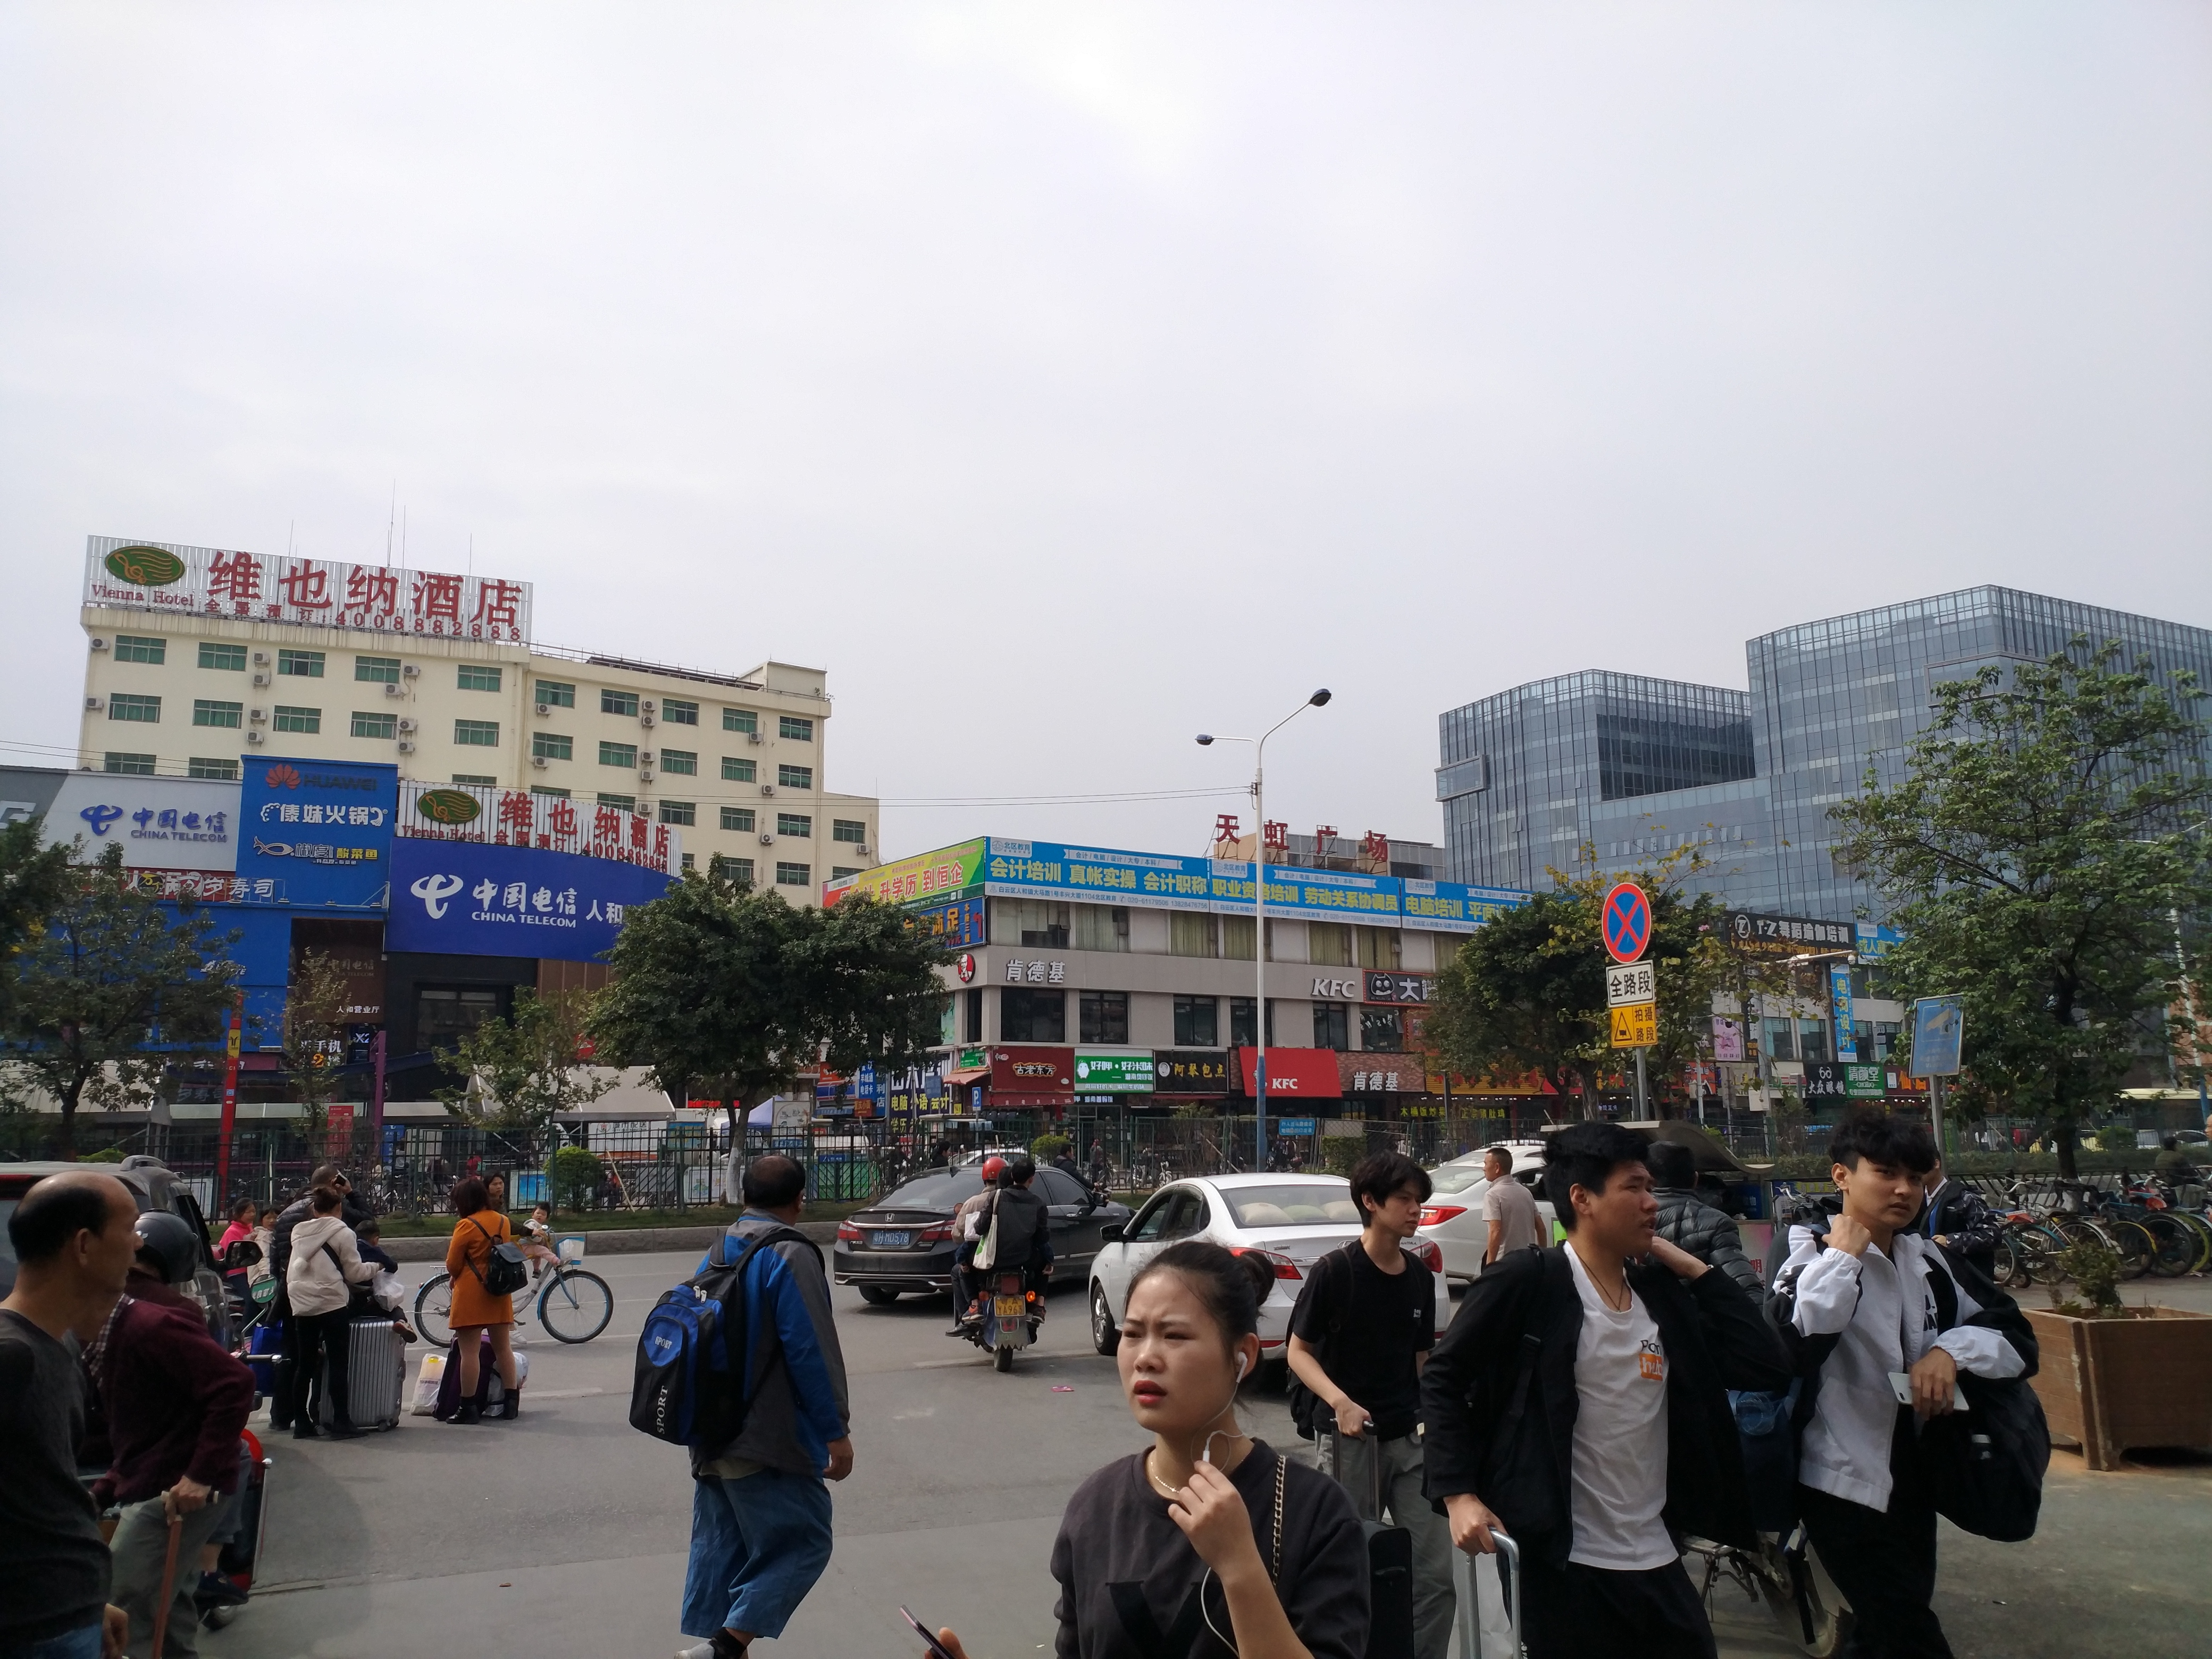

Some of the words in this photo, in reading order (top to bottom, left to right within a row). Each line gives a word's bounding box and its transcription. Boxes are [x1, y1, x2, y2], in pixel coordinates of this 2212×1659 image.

[91, 585, 144, 601] Vienna
[153, 590, 194, 606] Hotel
[208, 551, 522, 627] 维也纳酒店
[304, 774, 378, 791] HUAWEI
[132, 807, 228, 833] 中国电信
[499, 790, 670, 858] 维也纳酒店
[131, 830, 168, 840] CHINA
[169, 832, 227, 843] TELECOM
[402, 825, 445, 839] Vienna
[449, 828, 486, 842] Hotel
[1217, 814, 1388, 862] 天虹广场
[1004, 842, 1030, 851] 北区教育
[880, 873, 918, 900] 升学历
[922, 860, 963, 894] 到恒企
[990, 857, 1061, 883] 会计培训
[1143, 872, 1208, 895] 会计职称
[472, 878, 578, 915] 中国电信
[1304, 887, 1398, 911] 劳动关系协调员
[1405, 895, 1463, 919] 电脑培训
[472, 911, 516, 923] CHINA
[519, 914, 576, 928] TELECOM
[1007, 960, 1066, 983] 肯德基
[1312, 978, 1355, 998] KFC
[1610, 970, 1652, 998] 全路段
[336, 1006, 380, 1014] 人和营业厅
[1635, 1007, 1653, 1022] 拍摄
[1636, 1026, 1655, 1042] 路段
[1014, 1064, 1055, 1076] 古老东方
[1272, 1078, 1298, 1089] KFC
[1353, 1071, 1398, 1091] 肯德基
[1808, 1080, 1846, 1095] 大众眼镜
[891, 1095, 908, 1111] 电脑
[655, 1335, 673, 1350] SPORT
[657, 1385, 668, 1435] SPORT
